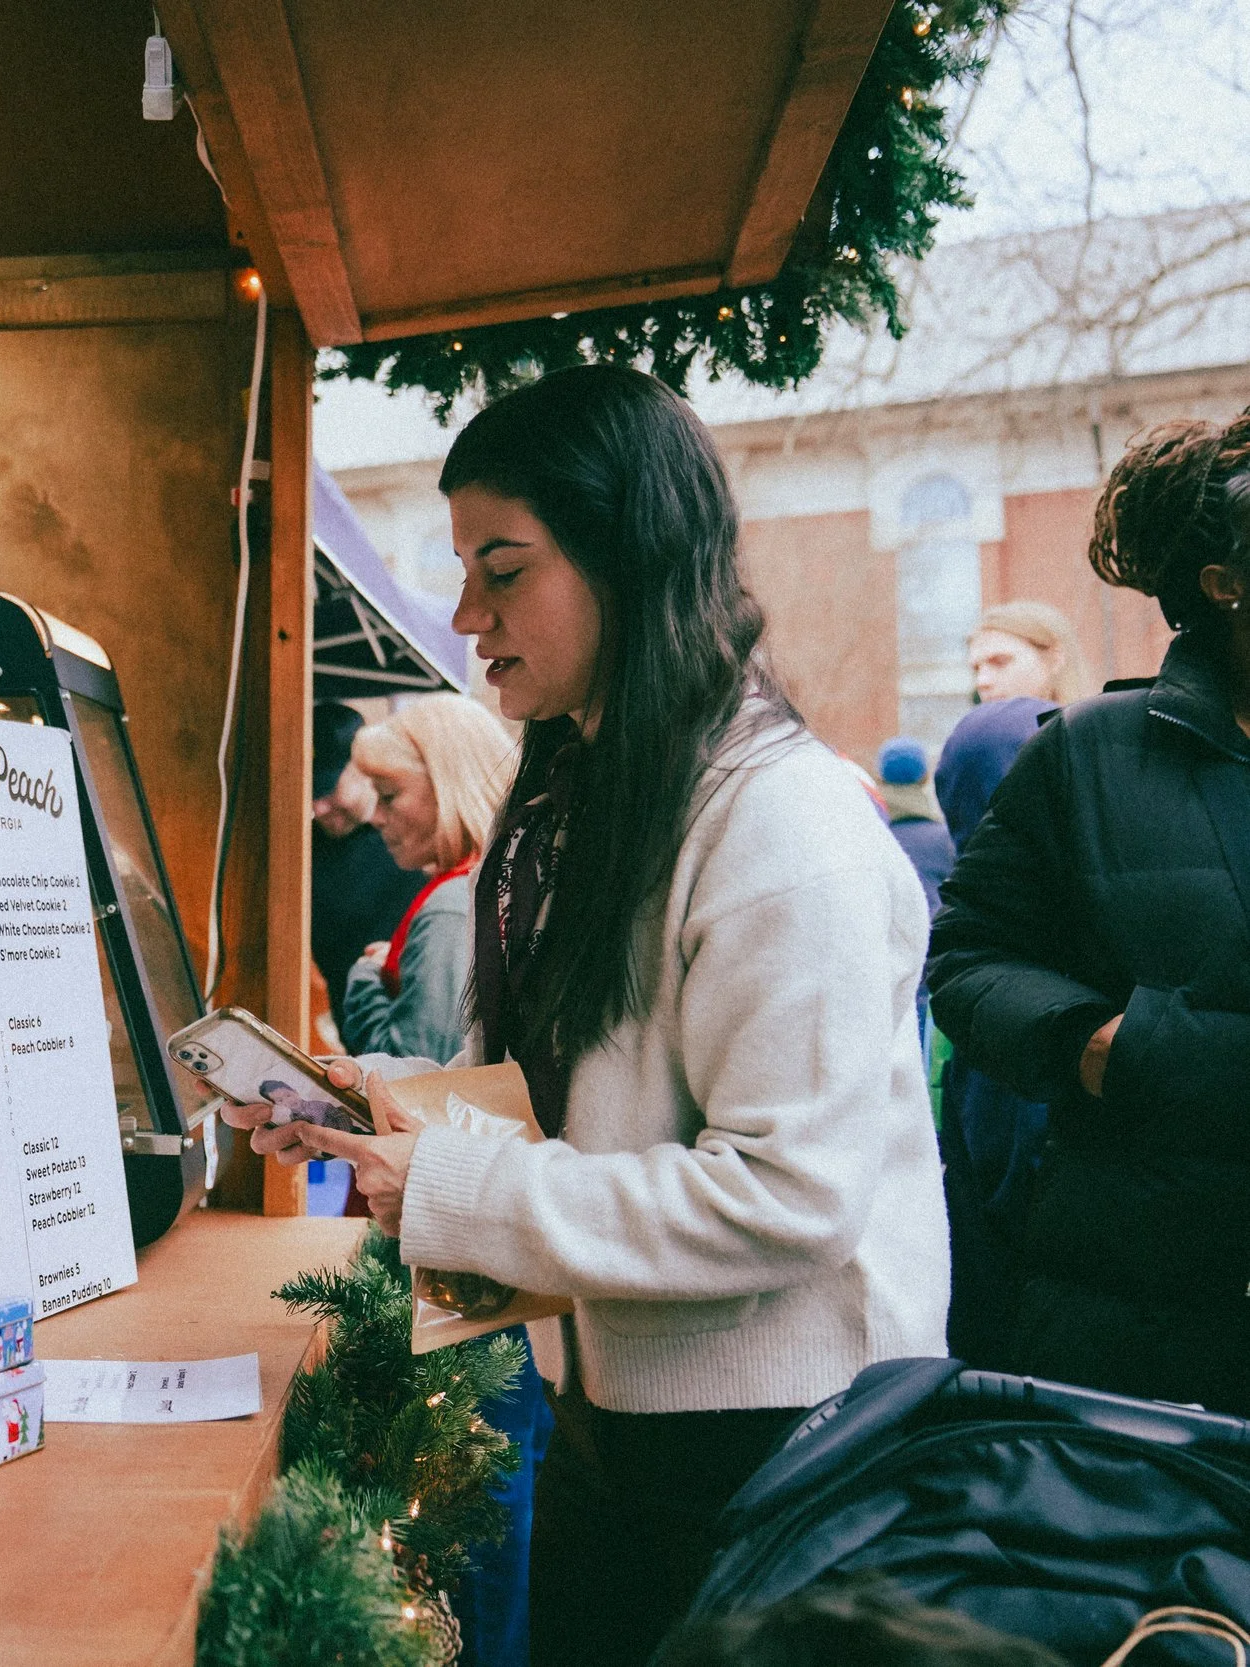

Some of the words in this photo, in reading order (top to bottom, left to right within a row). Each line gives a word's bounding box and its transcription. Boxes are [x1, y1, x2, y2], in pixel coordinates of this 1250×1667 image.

[31, 875, 48, 890] Chip
[50, 875, 73, 888] Cookie
[75, 876, 80, 887] 2
[10, 899, 34, 912] Velvet
[36, 898, 61, 912] Cookie
[62, 899, 67, 911] 2
[22, 922, 59, 936] Chocolate
[61, 922, 85, 935] Cookie
[86, 922, 91, 934] 2
[0, 948, 28, 961] S'more
[29, 947, 55, 960] Cookie
[56, 947, 61, 959] 2
[8, 1014, 36, 1030] Classic
[37, 1015, 42, 1027] 6
[11, 1039, 35, 1056] Peach
[37, 1037, 66, 1052] Cobbler
[69, 1036, 74, 1048] 8
[23, 1137, 50, 1156] Classic
[51, 1136, 59, 1150] 12
[26, 1165, 51, 1181] Sweet
[52, 1160, 77, 1176] Potato
[78, 1155, 86, 1169] 13
[29, 1186, 72, 1206] Strawberry
[73, 1182, 81, 1195] 12
[32, 1213, 56, 1232] Peach
[57, 1206, 87, 1225] Cobbler
[87, 1202, 96, 1216] 12
[39, 1266, 74, 1287] Brownies
[75, 1263, 81, 1276] 5
[42, 1293, 71, 1313] Banana
[72, 1281, 102, 1301] Pudding
[103, 1277, 112, 1291] 10
